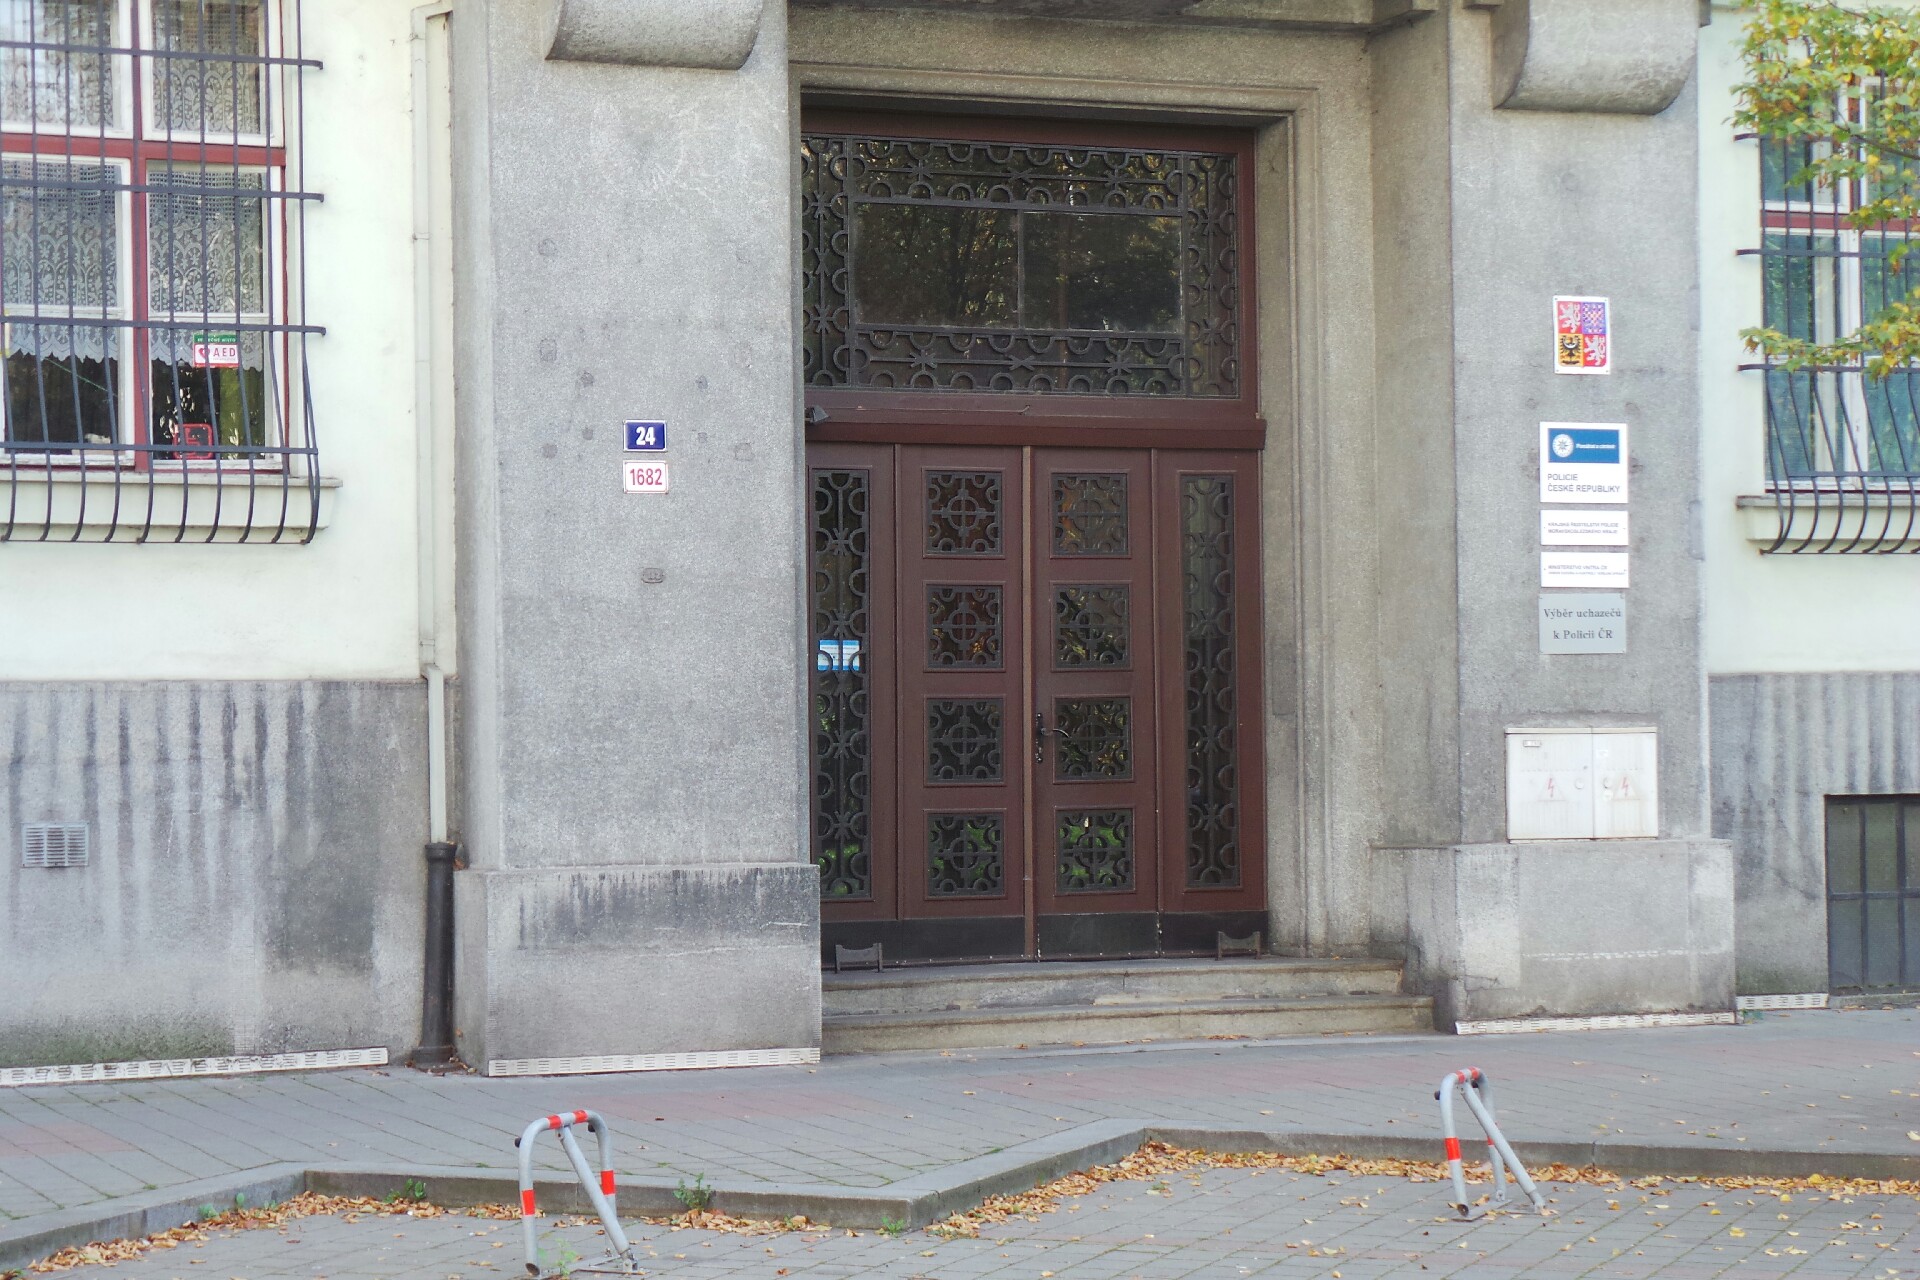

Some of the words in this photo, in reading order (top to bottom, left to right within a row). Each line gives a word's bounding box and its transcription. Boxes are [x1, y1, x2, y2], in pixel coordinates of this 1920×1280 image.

[213, 347, 236, 357] AED
[635, 426, 656, 446] 24
[629, 468, 663, 486] 1682
[1547, 473, 1579, 481] POLICIE
[1547, 483, 1574, 492] ČESKÉ
[1576, 484, 1620, 493] REPUBLIKY
[1543, 608, 1573, 619] Výběr
[1576, 608, 1621, 618] uchazečů
[1553, 630, 1560, 639] k
[1563, 630, 1595, 640] Policii
[1597, 628, 1613, 639] ČR
